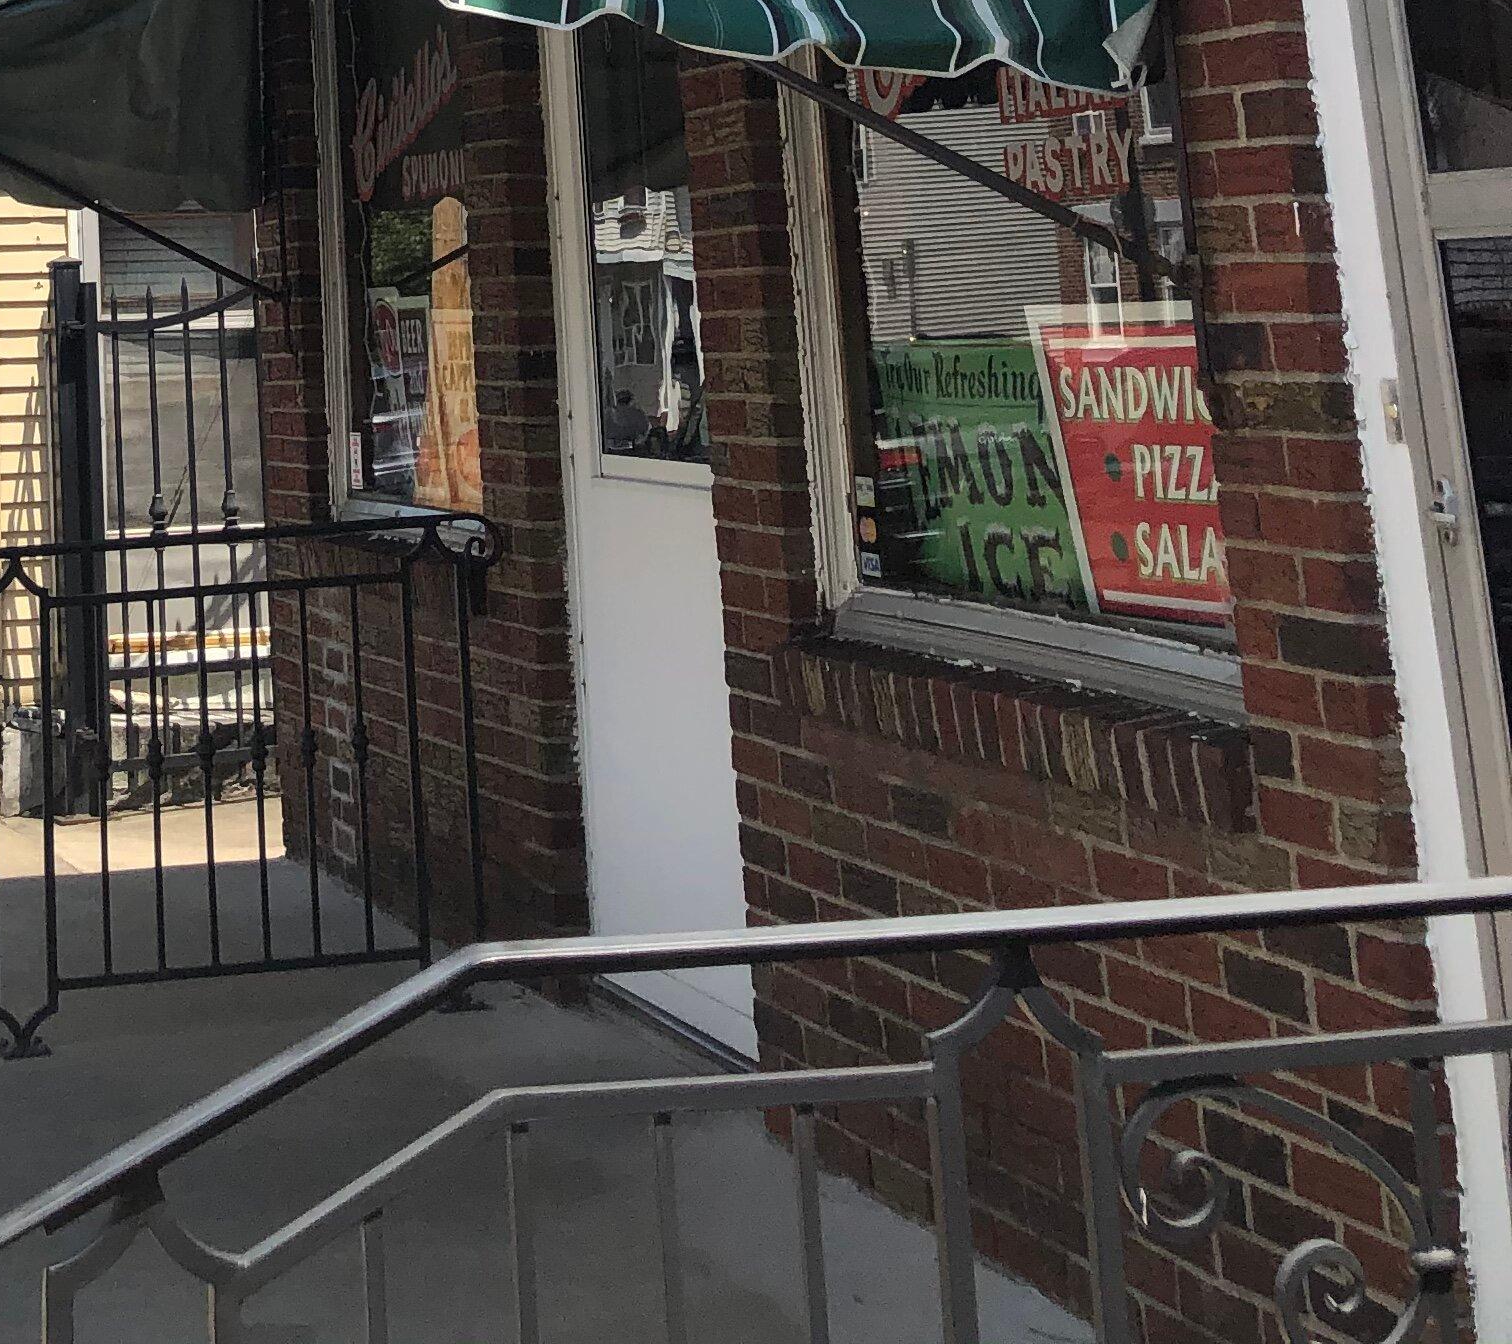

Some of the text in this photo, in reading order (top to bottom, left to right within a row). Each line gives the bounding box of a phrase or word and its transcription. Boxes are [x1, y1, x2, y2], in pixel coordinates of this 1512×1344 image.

[401, 149, 466, 200] SPUMONI
[1003, 128, 1133, 195] PASTRY
[1134, 444, 1219, 502] PIZZ
[957, 515, 1076, 608] ICE
